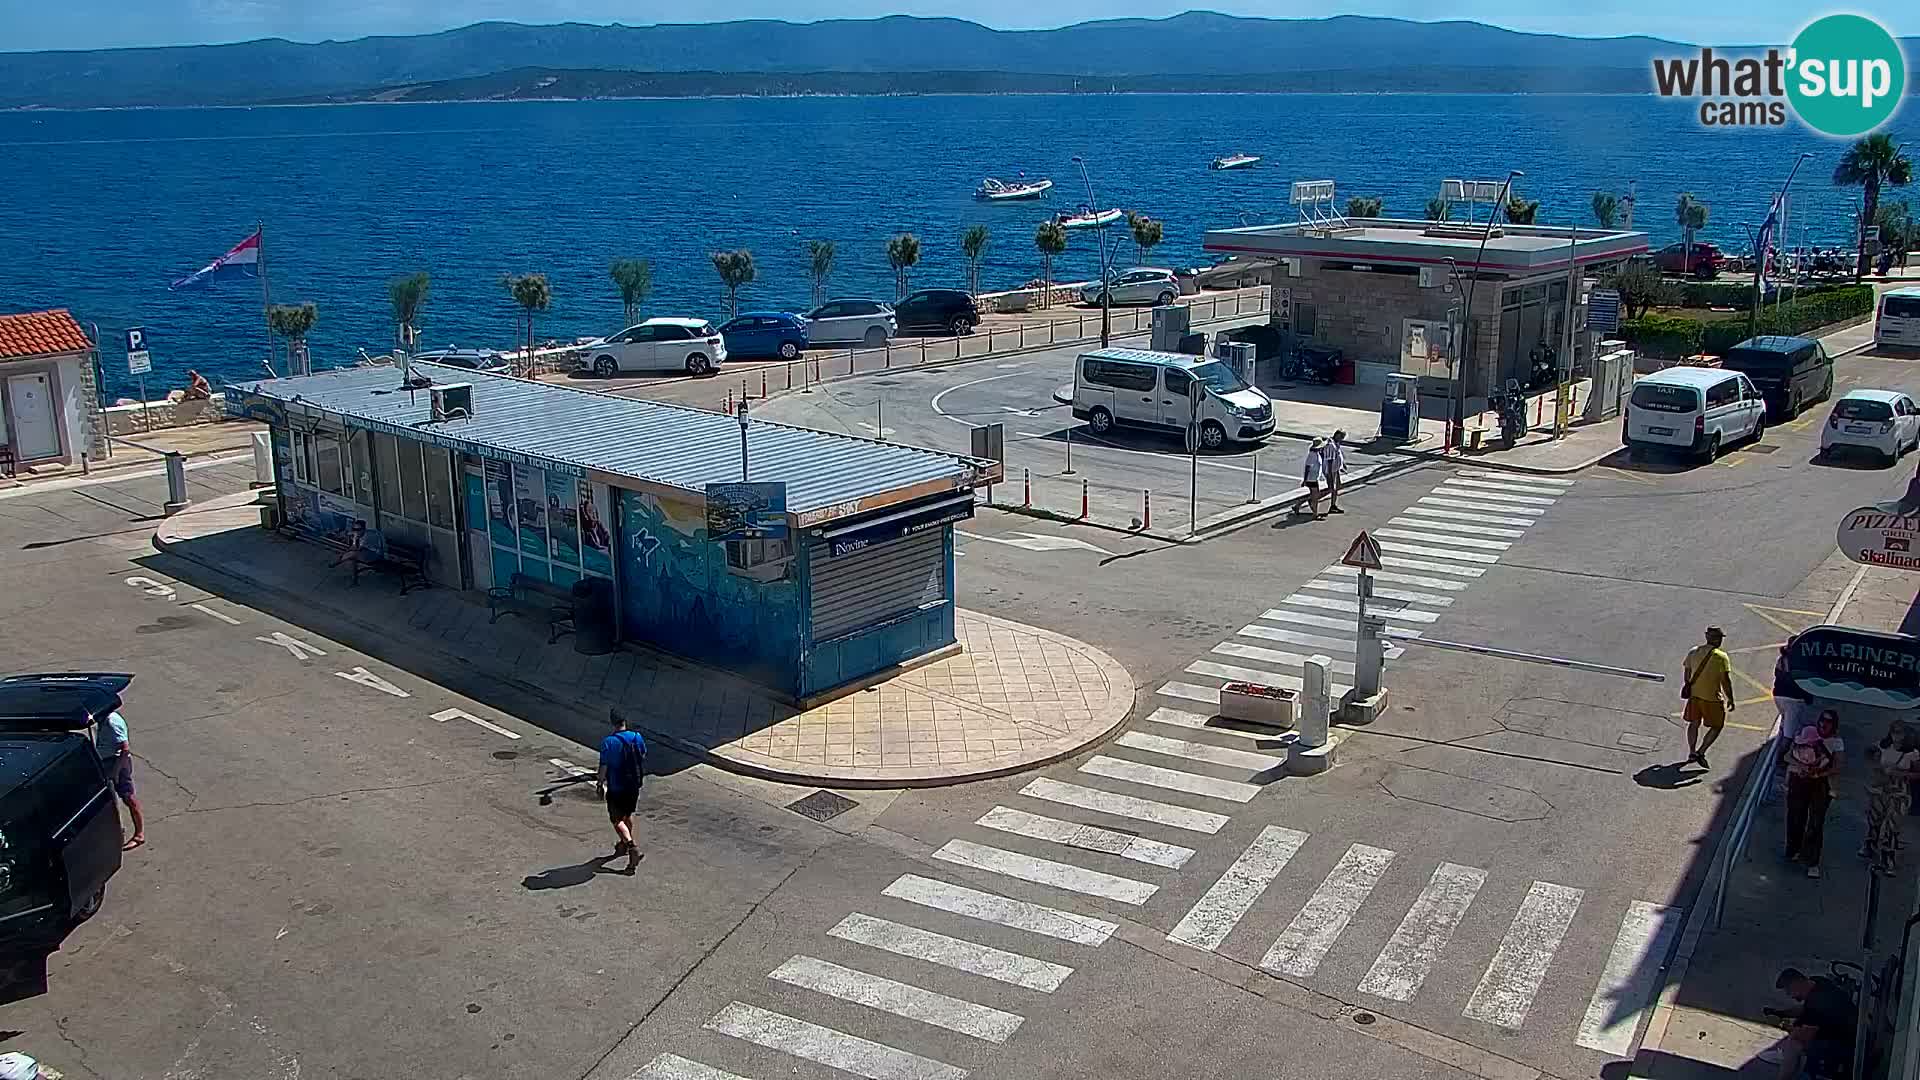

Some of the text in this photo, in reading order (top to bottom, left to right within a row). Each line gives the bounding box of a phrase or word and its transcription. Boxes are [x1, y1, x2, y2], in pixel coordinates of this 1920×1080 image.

[130, 330, 142, 349] P
[1657, 386, 1675, 395] TAXI
[395, 426, 435, 444] AUTOBUSNA
[436, 435, 467, 451] POSTAJA
[477, 446, 493, 458] BUS
[493, 449, 526, 464] STATION
[527, 456, 554, 471] TICKET
[554, 461, 583, 477] OFFICE
[1828, 661, 1897, 680] caffe bar
